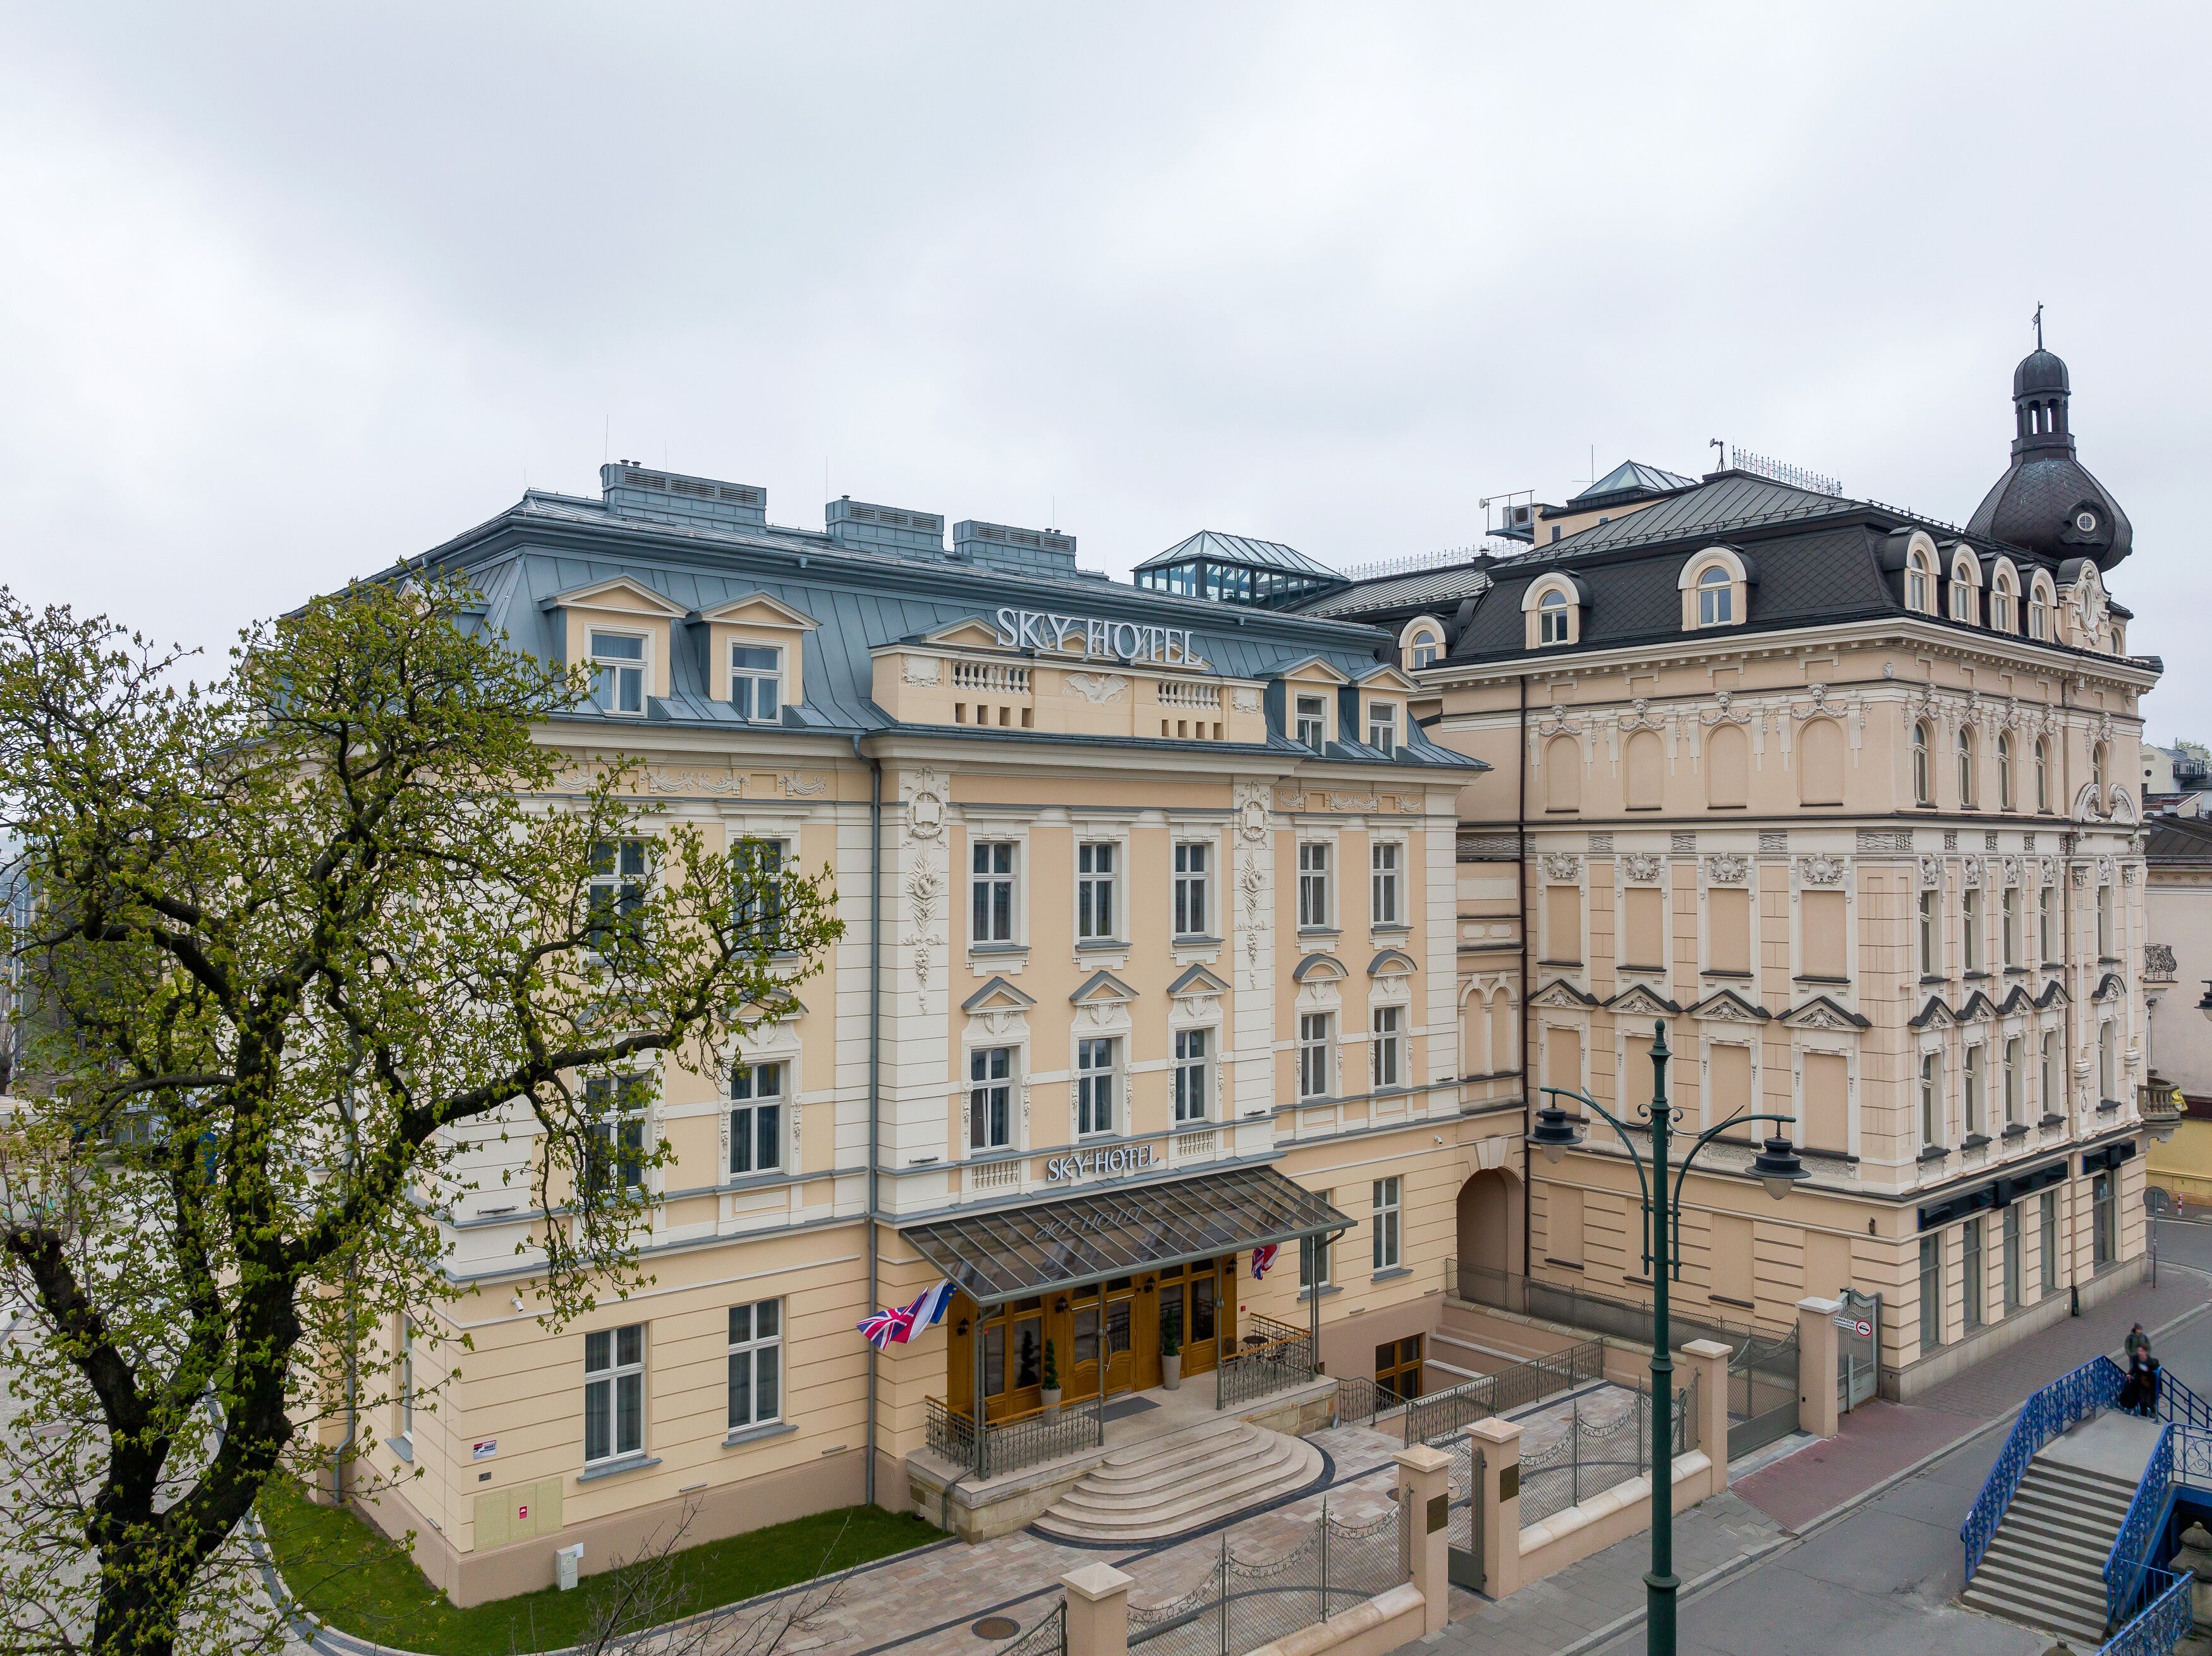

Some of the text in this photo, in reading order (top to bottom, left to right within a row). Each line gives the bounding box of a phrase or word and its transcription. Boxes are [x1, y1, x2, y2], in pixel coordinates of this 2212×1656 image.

[996, 607, 1203, 665] SKY HOTEL
[1047, 1145, 1160, 1182] SKY HOTEL
[1834, 1317, 1854, 1325] UWAGA
